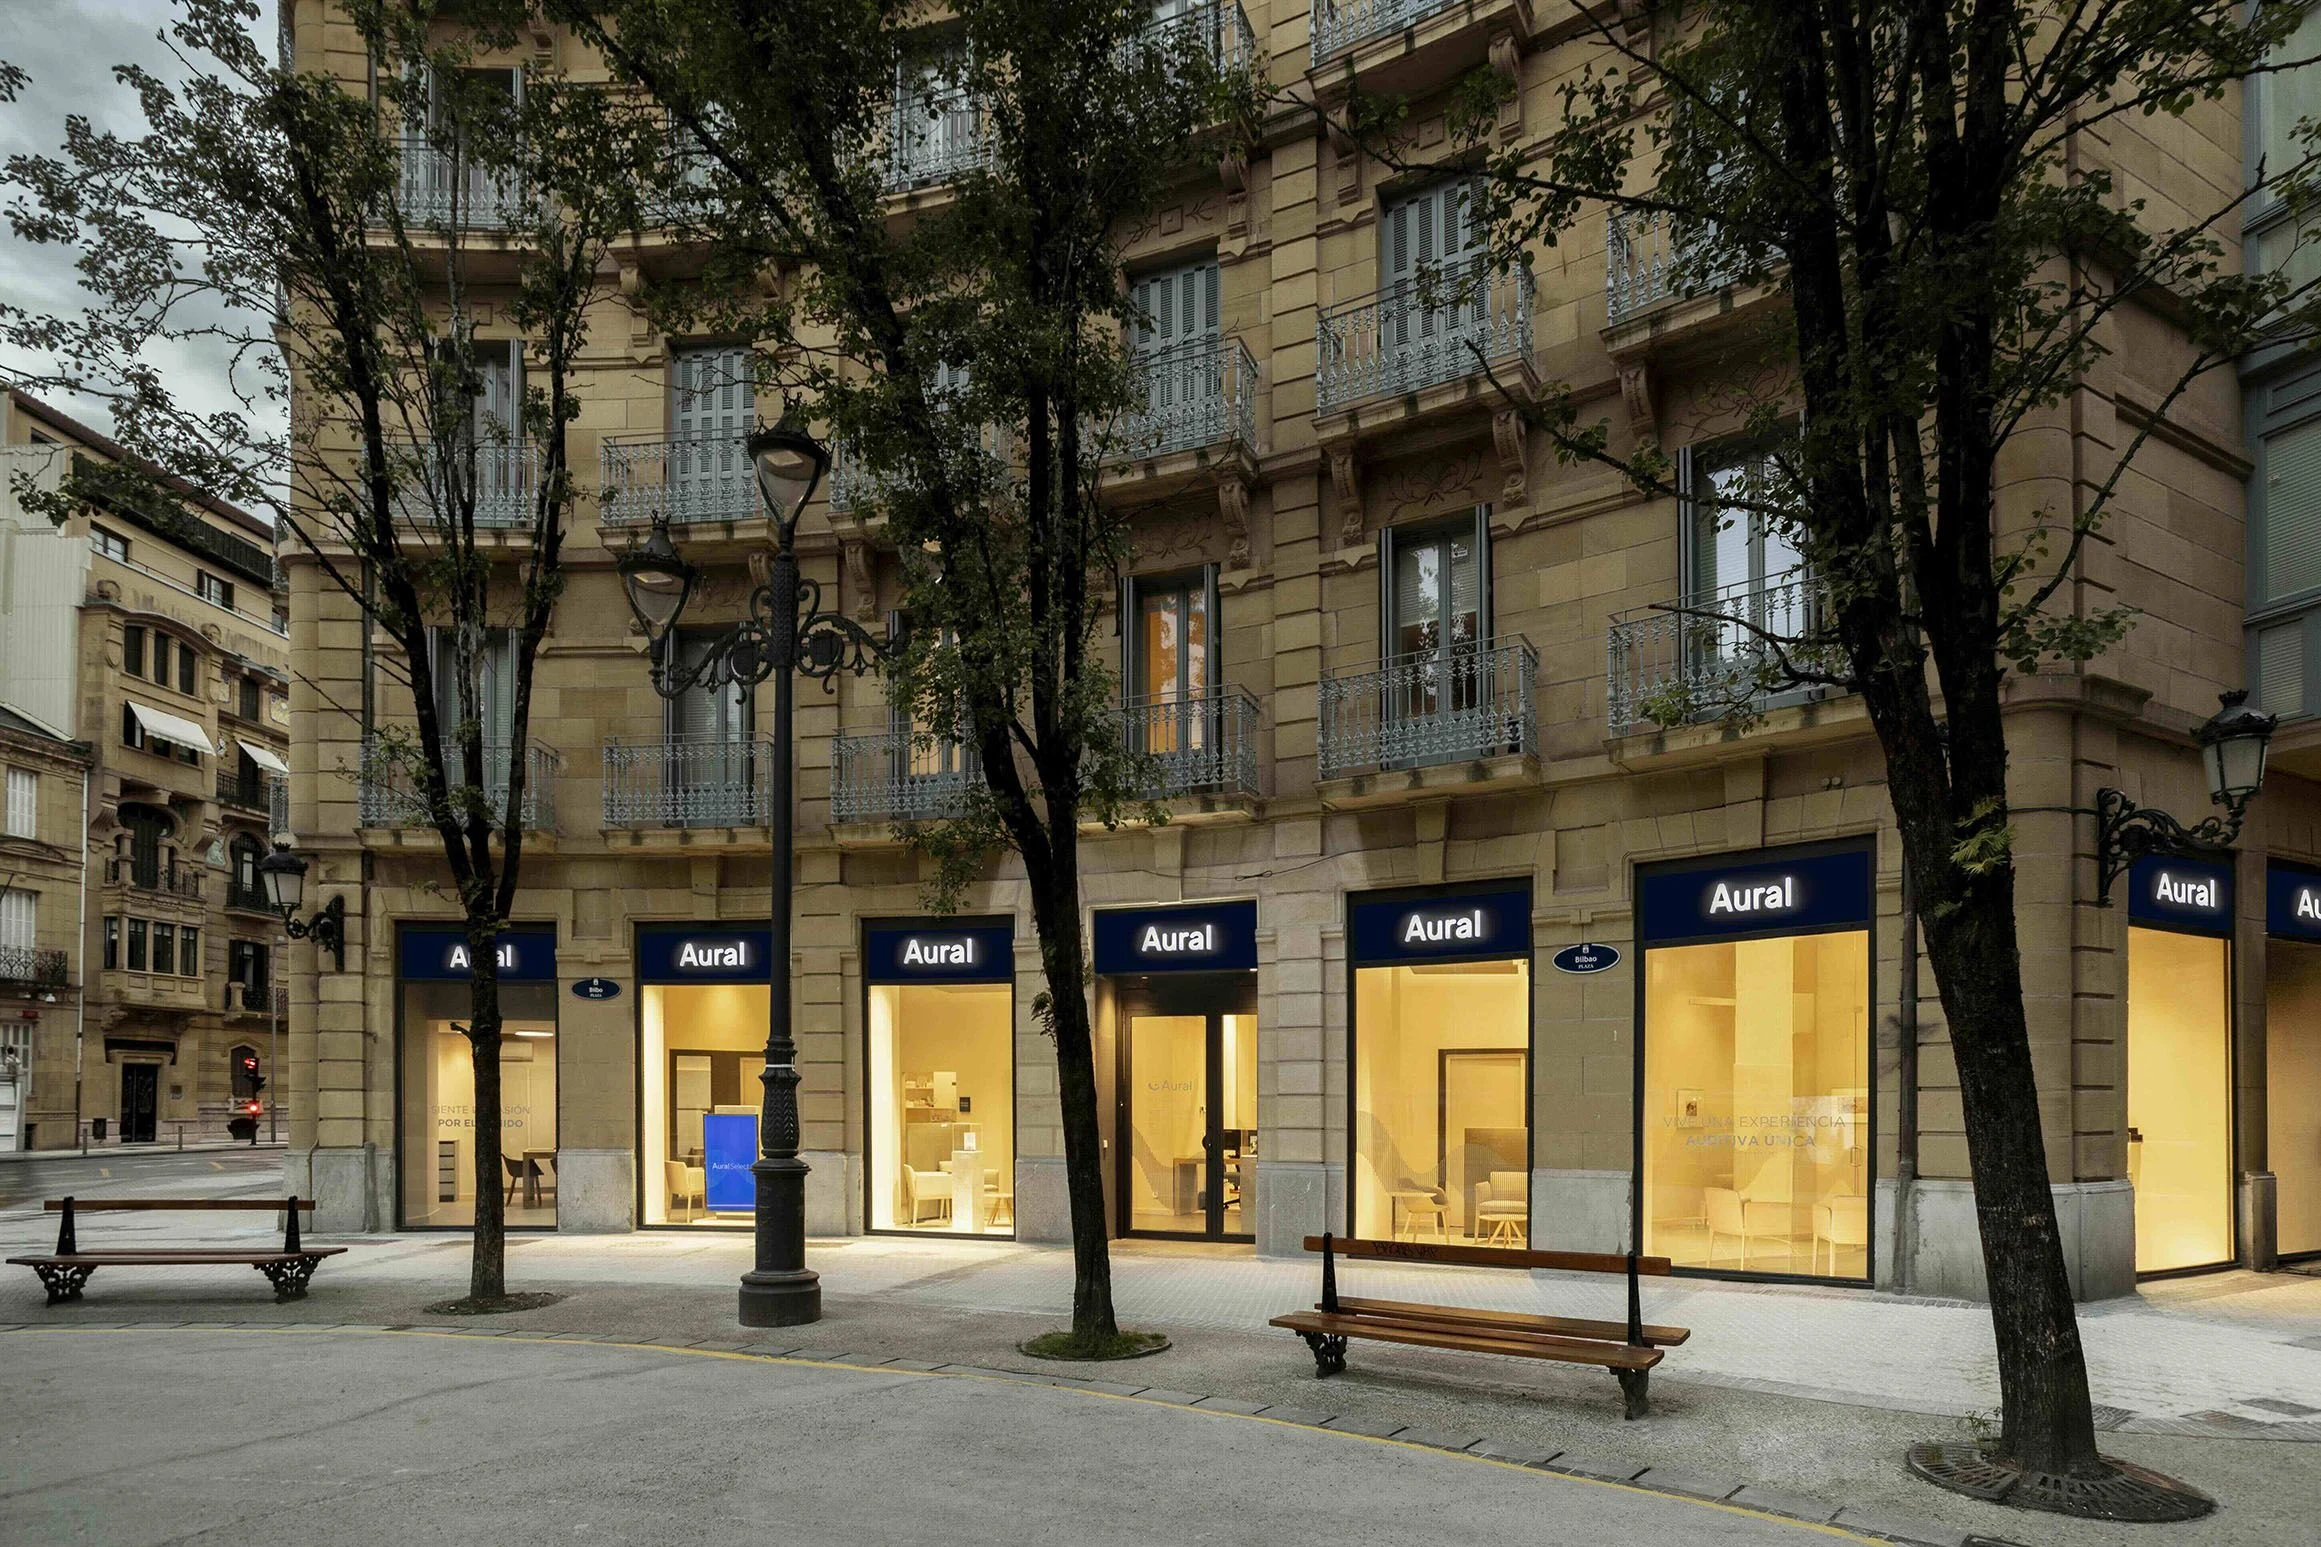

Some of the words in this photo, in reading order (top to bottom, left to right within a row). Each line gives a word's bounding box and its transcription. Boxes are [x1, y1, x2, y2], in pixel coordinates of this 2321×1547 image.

[1709, 877, 1792, 914] Aural
[2156, 872, 2216, 908] Aural
[1404, 910, 1481, 942] Aural
[1141, 924, 1212, 952] Aural
[679, 941, 745, 967] Aural
[903, 938, 973, 964] Aural
[1574, 955, 1598, 964] Bilbao
[1160, 1079, 1193, 1092] Aural
[431, 1105, 469, 1114] SIENTE
[438, 1119, 461, 1128] POR
[1702, 1116, 1733, 1128] UNA
[1739, 1115, 1846, 1128] EXPERIENCIA
[1686, 1135, 1759, 1146] AUDITIVA
